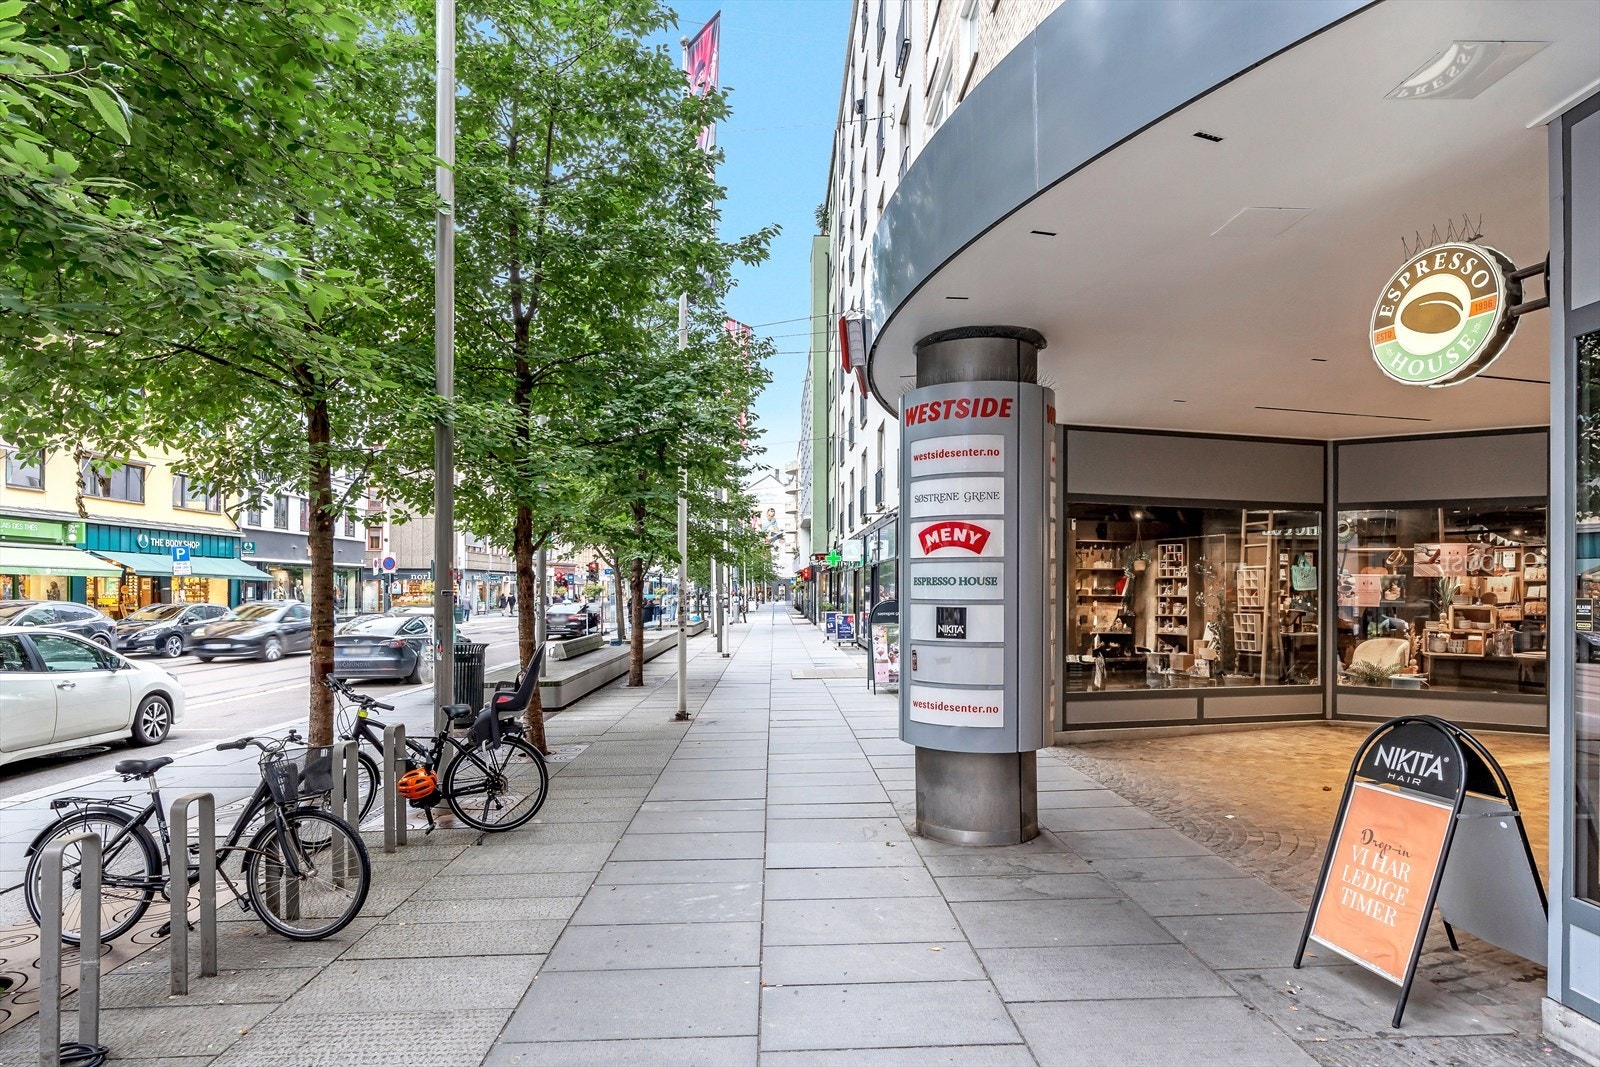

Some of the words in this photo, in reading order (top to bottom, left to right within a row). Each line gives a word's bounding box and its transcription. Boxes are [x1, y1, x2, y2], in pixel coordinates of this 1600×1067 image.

[1379, 252, 1490, 318] ESPRESSO
[1474, 299, 1493, 313] 1996
[1376, 331, 1393, 341] ESTD
[1390, 333, 1476, 376] HOUSE
[905, 397, 1014, 427] WESTSIDE
[913, 448, 1000, 462] westsidesenter.no
[914, 492, 960, 504] SØSTRENE
[963, 491, 1001, 503] GRENE
[150, 537, 164, 547] THE
[165, 538, 183, 547] BODY
[183, 540, 200, 549] SHOP
[924, 527, 982, 546] MENY
[176, 547, 186, 560] P
[913, 576, 956, 586] ESPRESSO
[958, 576, 998, 586] HOUSE
[937, 624, 964, 634] NIKITA
[912, 700, 999, 714] westsidesenter.no
[1387, 772, 1422, 786] HAIR
[1361, 828, 1413, 859] Drop-in
[1351, 844, 1374, 868] VI
[1373, 853, 1412, 883] HAR
[1342, 864, 1409, 907] LEDIGE
[1339, 885, 1398, 928] TIMER
